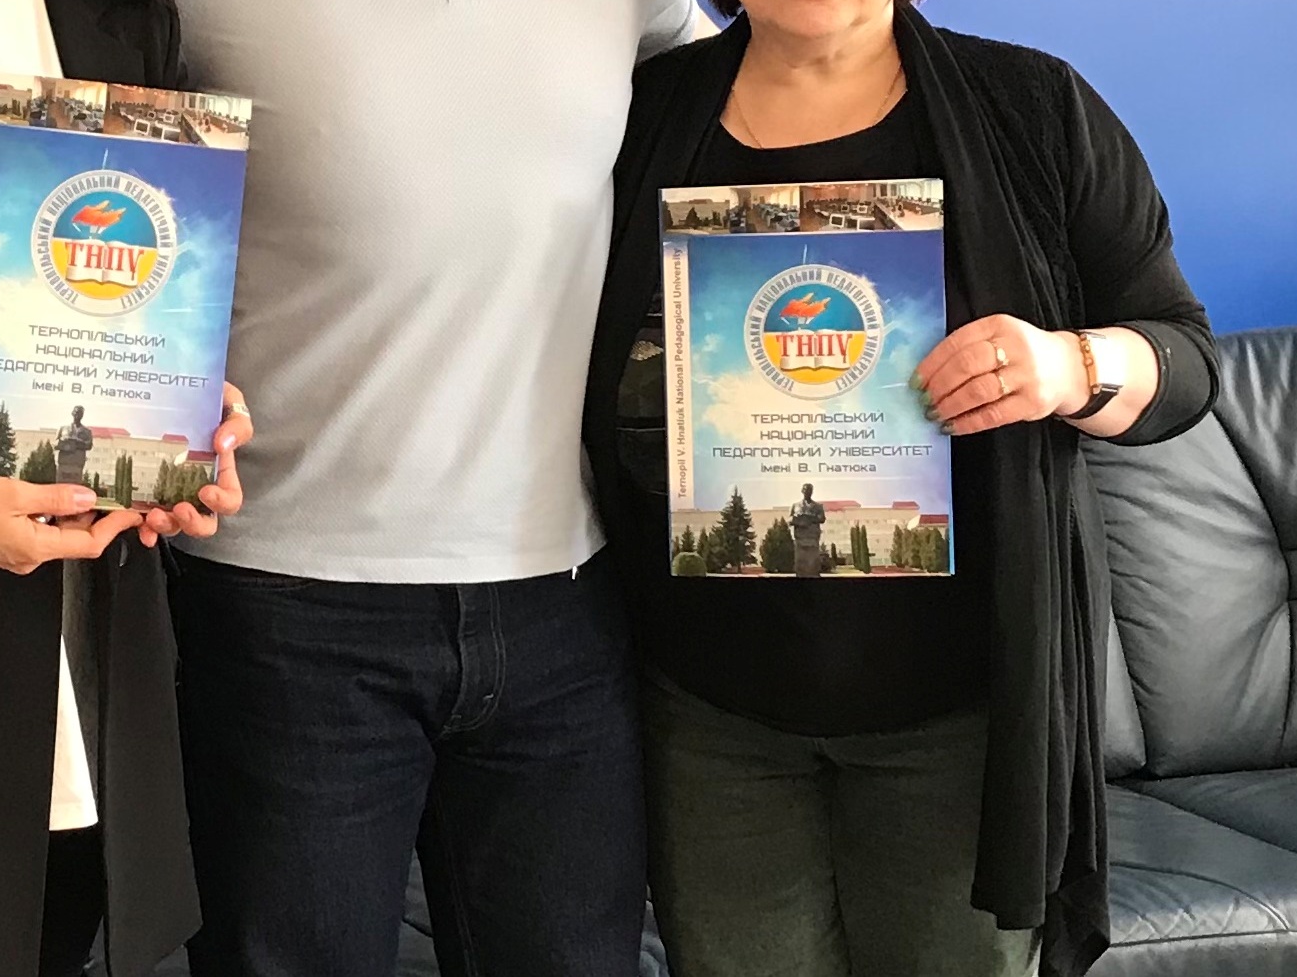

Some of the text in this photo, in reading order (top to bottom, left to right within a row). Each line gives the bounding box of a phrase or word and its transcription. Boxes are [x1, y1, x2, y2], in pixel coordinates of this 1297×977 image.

[46, 176, 121, 216] НАЦІОНАЛЬНИЙ
[124, 180, 173, 248] ПЕДАГОГІЧНИЙ
[65, 241, 144, 281] ТНПУ
[672, 248, 683, 298] University
[28, 324, 166, 348] ТЕРНОПІЛЬСЬКИЙ
[673, 301, 684, 362] Pedagogical
[35, 343, 155, 365] НАЦІОНАЛЬНИЙ
[775, 333, 853, 363] ТНПУ
[71, 383, 85, 394] В.
[92, 384, 152, 400] Гнатюка
[105, 369, 209, 389] УНІВЕРСИТЕТ
[676, 364, 684, 404] National
[676, 407, 685, 445] Hnatiuk
[751, 409, 884, 424] ТЕРНОПІЛЬСЬКИЙ
[760, 426, 875, 441] НАЦІОНАЛЬНИЙ
[829, 445, 932, 457] УНІВЕРСИТЕТ
[678, 459, 687, 498] Ternopil
[798, 463, 811, 472] В.
[818, 463, 877, 472] Гнатюка
